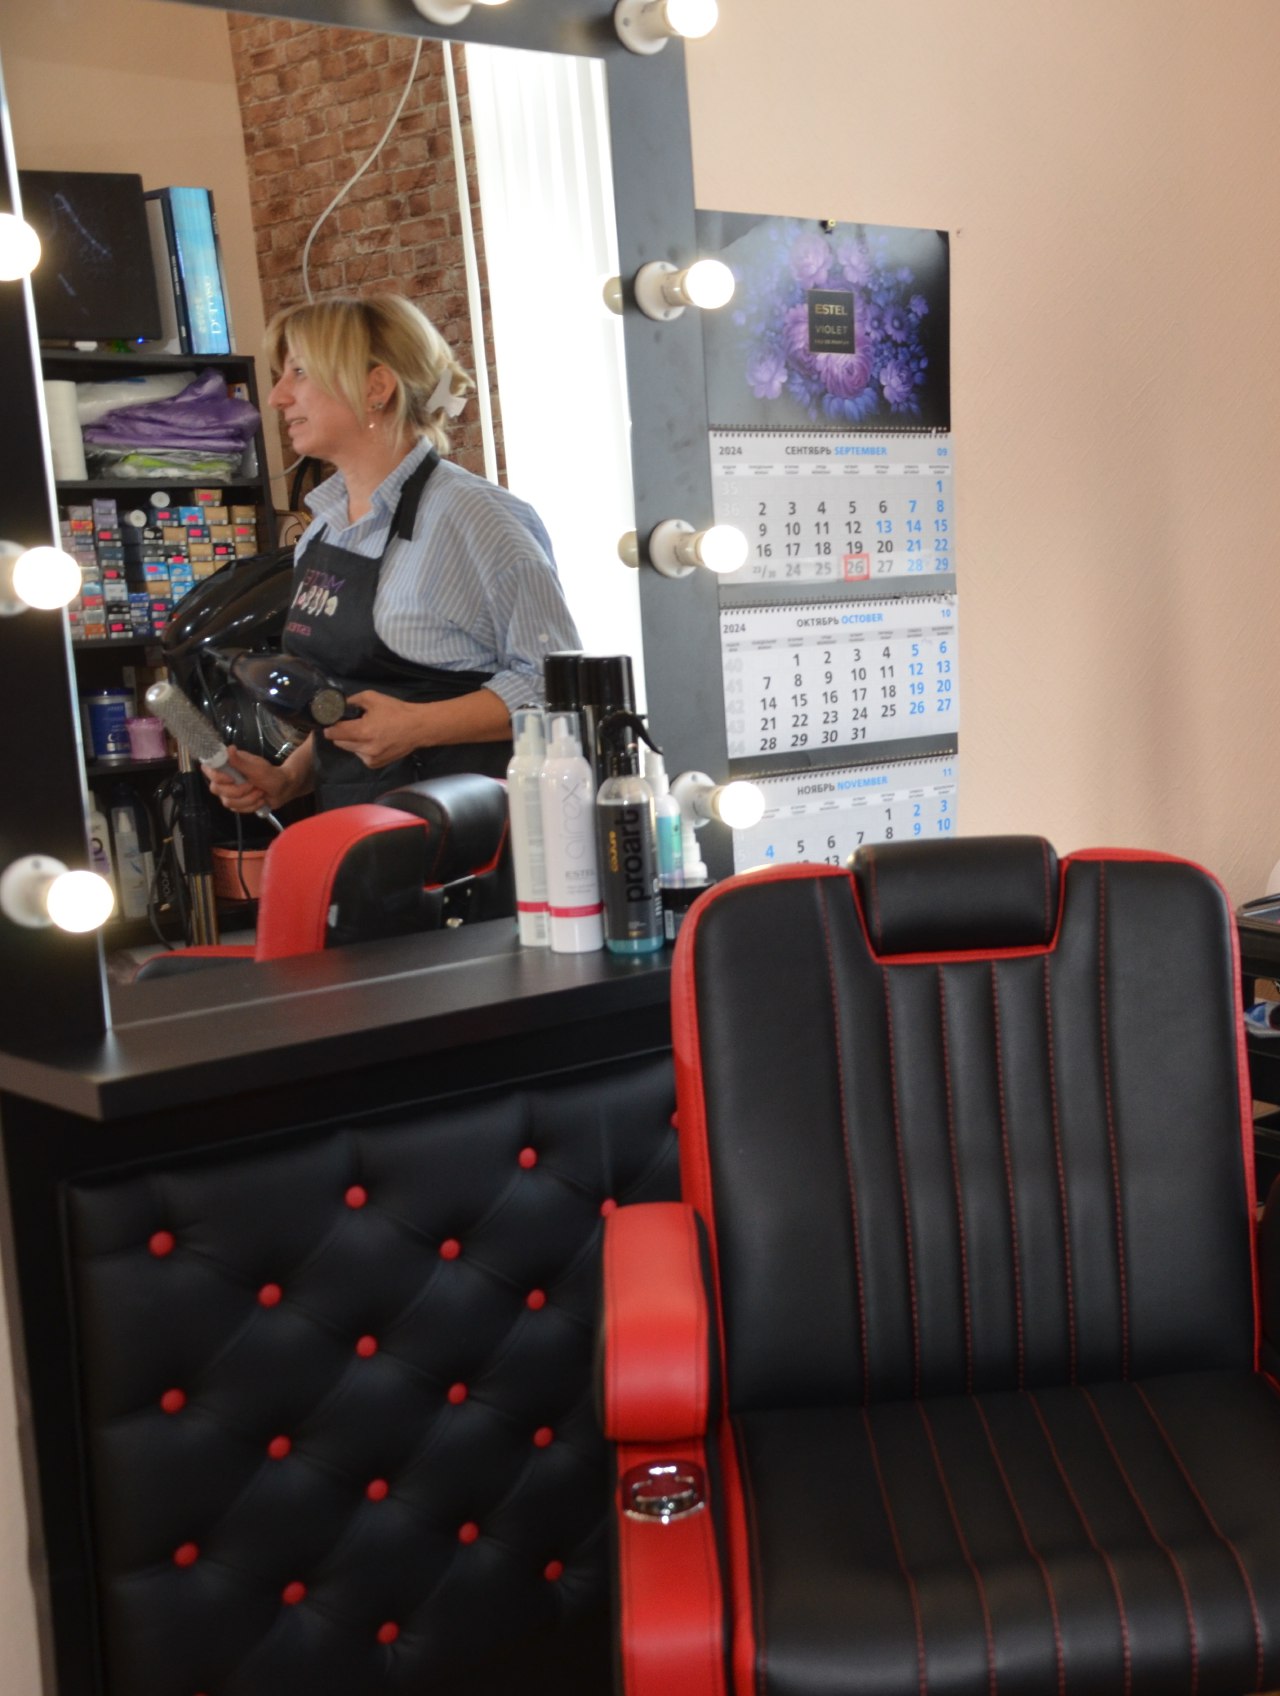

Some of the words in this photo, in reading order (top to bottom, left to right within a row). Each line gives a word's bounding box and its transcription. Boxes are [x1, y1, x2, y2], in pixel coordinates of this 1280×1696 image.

[815, 304, 848, 315] ESTEL
[815, 325, 848, 335] VIOLET
[719, 447, 743, 456] 2024
[784, 446, 832, 456] СЕНТЯБРЬ
[834, 447, 887, 456] SEPTEMBER
[936, 448, 949, 457] 09
[758, 502, 767, 517] 2
[788, 502, 797, 516] 3
[817, 502, 827, 515] 4
[848, 501, 857, 515] 5
[878, 501, 888, 514] 6
[908, 500, 918, 513] 7
[936, 500, 945, 513] 8
[758, 523, 768, 537] 9
[784, 522, 801, 536] 10
[814, 522, 830, 535] 11
[844, 521, 862, 534] 12
[875, 520, 893, 534] 13
[906, 520, 923, 533] 14
[933, 519, 949, 533] 15
[756, 544, 773, 558] 16
[785, 543, 801, 557] 17
[814, 542, 832, 556] 18
[845, 541, 863, 554] 19
[876, 540, 894, 554] 20
[906, 539, 922, 554] 21
[934, 538, 949, 553] 22
[785, 563, 802, 578] 24
[814, 562, 832, 576] 25
[846, 560, 865, 574] 26
[877, 560, 894, 574] 27
[907, 558, 924, 574] 28
[935, 558, 949, 572] 29
[796, 617, 840, 628] ОКТЯБРЬ
[840, 613, 884, 625] OCTOBER
[940, 609, 952, 618] 10
[723, 624, 747, 634] 2024
[823, 651, 832, 665] 2
[853, 649, 862, 662] 3
[882, 647, 891, 659] 4
[911, 644, 920, 658] 5
[938, 641, 948, 655] 6
[763, 677, 772, 690] 7
[794, 674, 803, 688] 8
[824, 671, 833, 685] 9
[850, 668, 867, 681] 10
[879, 665, 894, 679] 11
[908, 663, 924, 676] 12
[936, 660, 951, 674] 13
[760, 697, 777, 711] 14
[791, 694, 808, 708] 15
[822, 691, 839, 705] 16
[851, 688, 868, 702] 17
[880, 685, 897, 699] 18
[909, 682, 925, 696] 19
[936, 679, 952, 694] 20
[760, 717, 776, 732] 21
[791, 714, 809, 728] 22
[822, 711, 839, 725] 23
[852, 707, 868, 721] 24
[881, 704, 897, 718] 25
[908, 702, 926, 715] 26
[936, 698, 952, 713] 27
[759, 737, 777, 752] 28
[790, 733, 809, 748] 29
[821, 730, 839, 744] 30
[850, 727, 866, 741] 31
[942, 768, 952, 777] 11
[796, 782, 836, 796] НОЯБРЬ
[836, 776, 889, 791] NOVEMBER
[913, 804, 921, 818] 2
[940, 800, 948, 813] 3
[560, 783, 586, 860] airex
[765, 845, 775, 859] 4
[797, 840, 805, 854] 5
[827, 836, 836, 849] 6
[856, 832, 865, 845] 7
[885, 827, 894, 840] 8
[912, 823, 922, 836] 9
[937, 818, 951, 832] 10
[614, 809, 651, 903] proart
